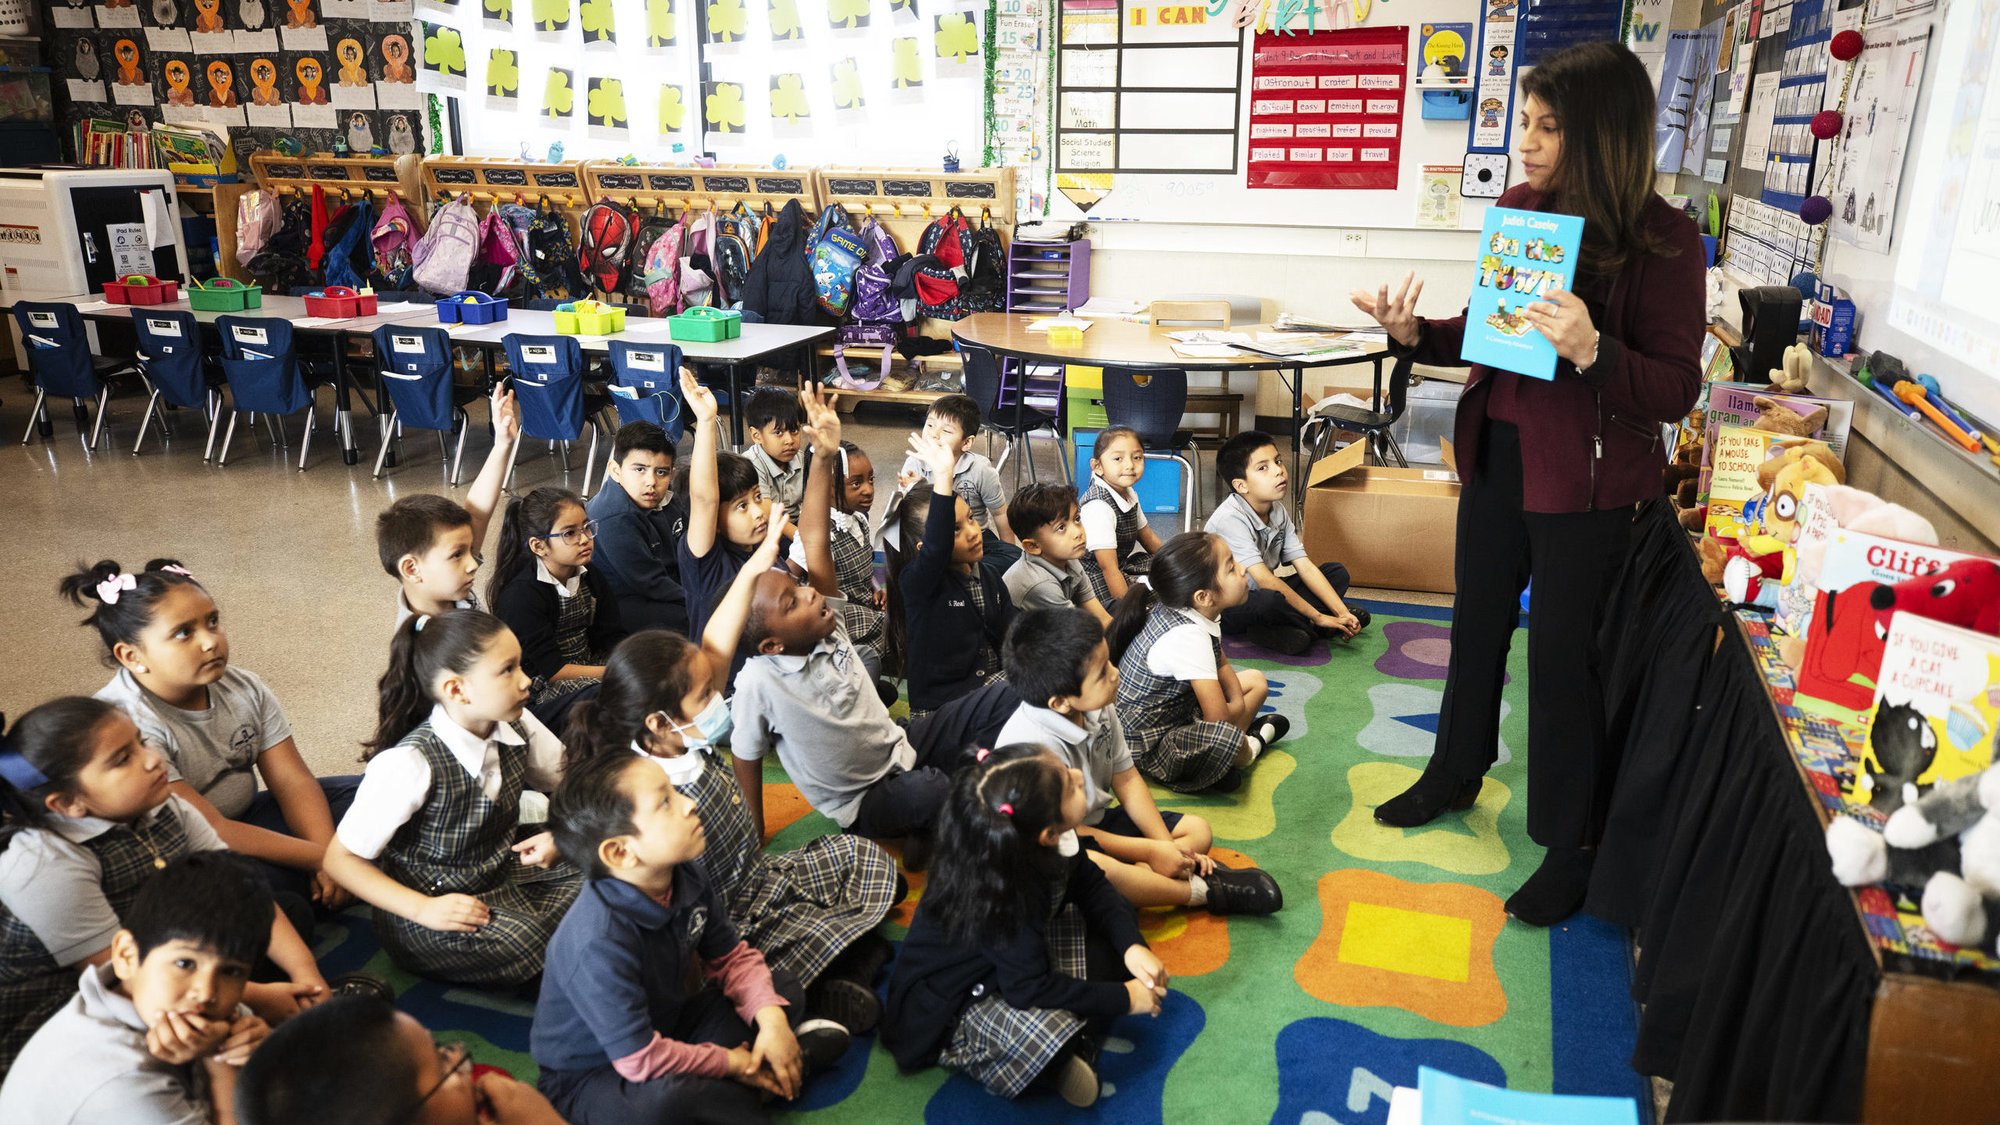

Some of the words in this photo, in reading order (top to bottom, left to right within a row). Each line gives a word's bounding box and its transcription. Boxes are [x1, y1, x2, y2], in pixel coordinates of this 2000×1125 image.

[1136, 9, 1142, 24] I
[1159, 7, 1204, 24] CAN
[1634, 21, 1661, 41] W
[1001, 31, 1017, 44] 15
[1363, 51, 1376, 60] and
[1015, 68, 1031, 80] 20
[1264, 79, 1310, 87] astronaut
[1324, 79, 1350, 87] crater
[1361, 77, 1393, 87] daytime
[1017, 86, 1033, 98] 25
[1075, 119, 1098, 128] Math
[1061, 138, 1082, 146] Social
[1084, 138, 1112, 146] Studies
[1071, 149, 1101, 157] Science
[1365, 150, 1386, 158] travel
[1070, 159, 1101, 168] Religion
[1502, 214, 1526, 227] Judith
[831, 233, 857, 252] GAME
[1489, 231, 1519, 257] On
[1525, 237, 1565, 264] the
[1728, 394, 1760, 414] llama
[1710, 409, 1740, 424] gram
[1743, 418, 1755, 428] an
[1720, 436, 1727, 446] IF
[1728, 437, 1742, 447] YOU
[1743, 437, 1760, 448] TAKE
[1725, 449, 1749, 459] MOUSE
[1718, 462, 1727, 471] TO
[1728, 462, 1756, 473] SCHOOL
[1867, 545, 1941, 577] Cliff
[1894, 632, 1904, 646] IF
[1910, 637, 1929, 653] YOU
[1932, 642, 1959, 660] GIVE
[1920, 658, 1942, 675] CAT
[1902, 673, 1953, 699] CUPCAKE
